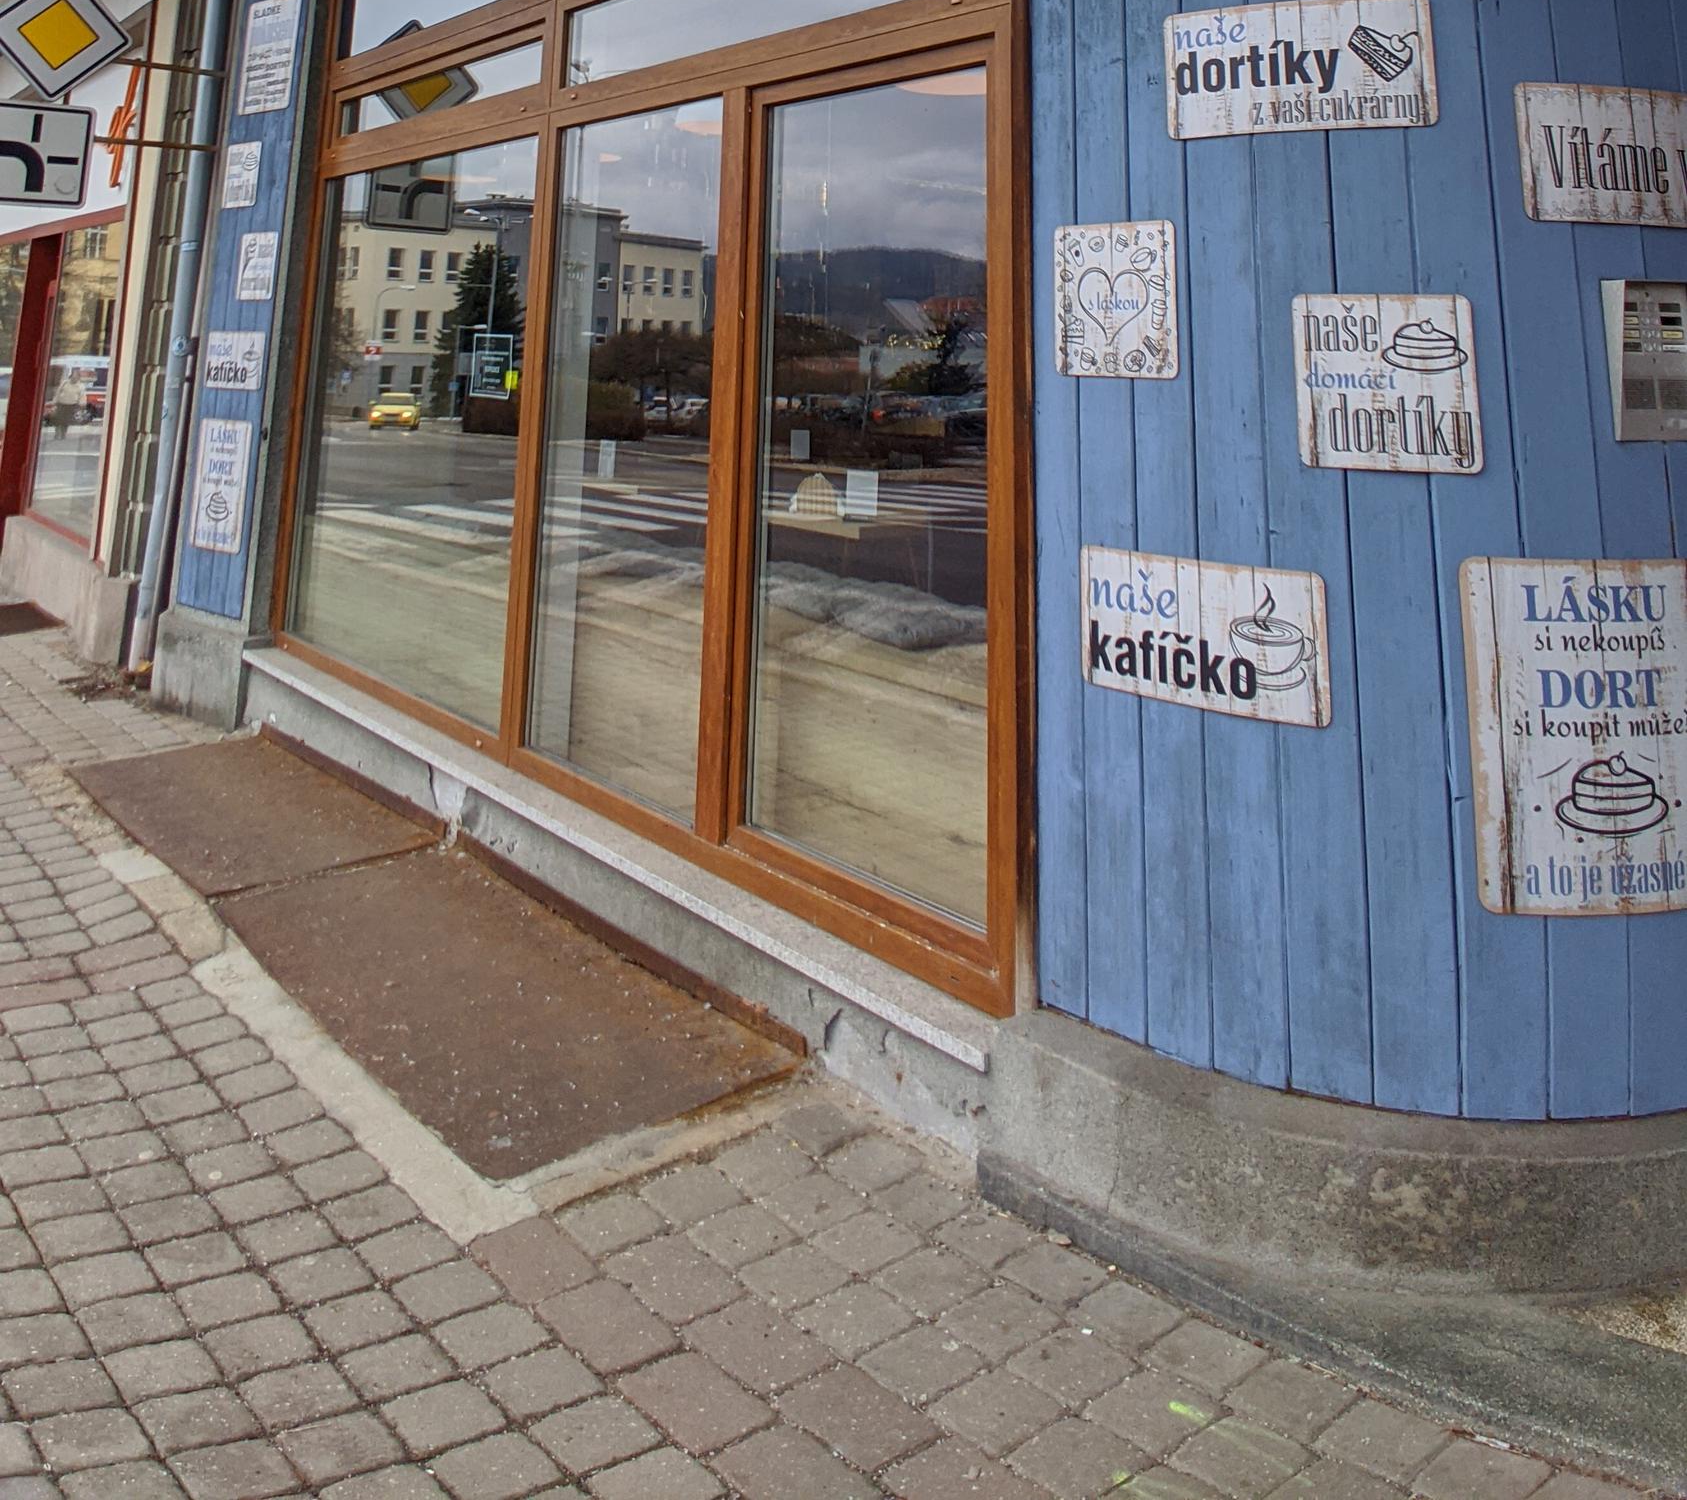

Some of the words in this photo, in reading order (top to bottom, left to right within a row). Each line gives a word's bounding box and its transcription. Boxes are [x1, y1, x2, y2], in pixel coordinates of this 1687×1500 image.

[1174, 15, 1247, 50] naše
[1176, 39, 1340, 96] dortíky
[1253, 101, 1264, 125] z
[1271, 92, 1313, 124] vaší
[1319, 88, 1420, 125] cukrárny
[1541, 125, 1669, 195] Vítáme
[1302, 303, 1378, 353] naše
[206, 360, 247, 383] kafíčko
[1304, 361, 1397, 390] domácí
[1329, 393, 1475, 469] dortíky
[1091, 568, 1178, 619] naše
[1521, 576, 1667, 623] LÁSKU
[1090, 619, 1257, 700] kafíčko
[1534, 631, 1553, 651] si
[1562, 625, 1666, 659] nekoupíš
[1537, 669, 1661, 709] DORT
[1513, 710, 1533, 736] si
[1542, 708, 1624, 745] koupit
[1629, 709, 1687, 736] může
[1527, 863, 1541, 896] a
[1550, 854, 1572, 895] to
[1581, 855, 1603, 901] je
